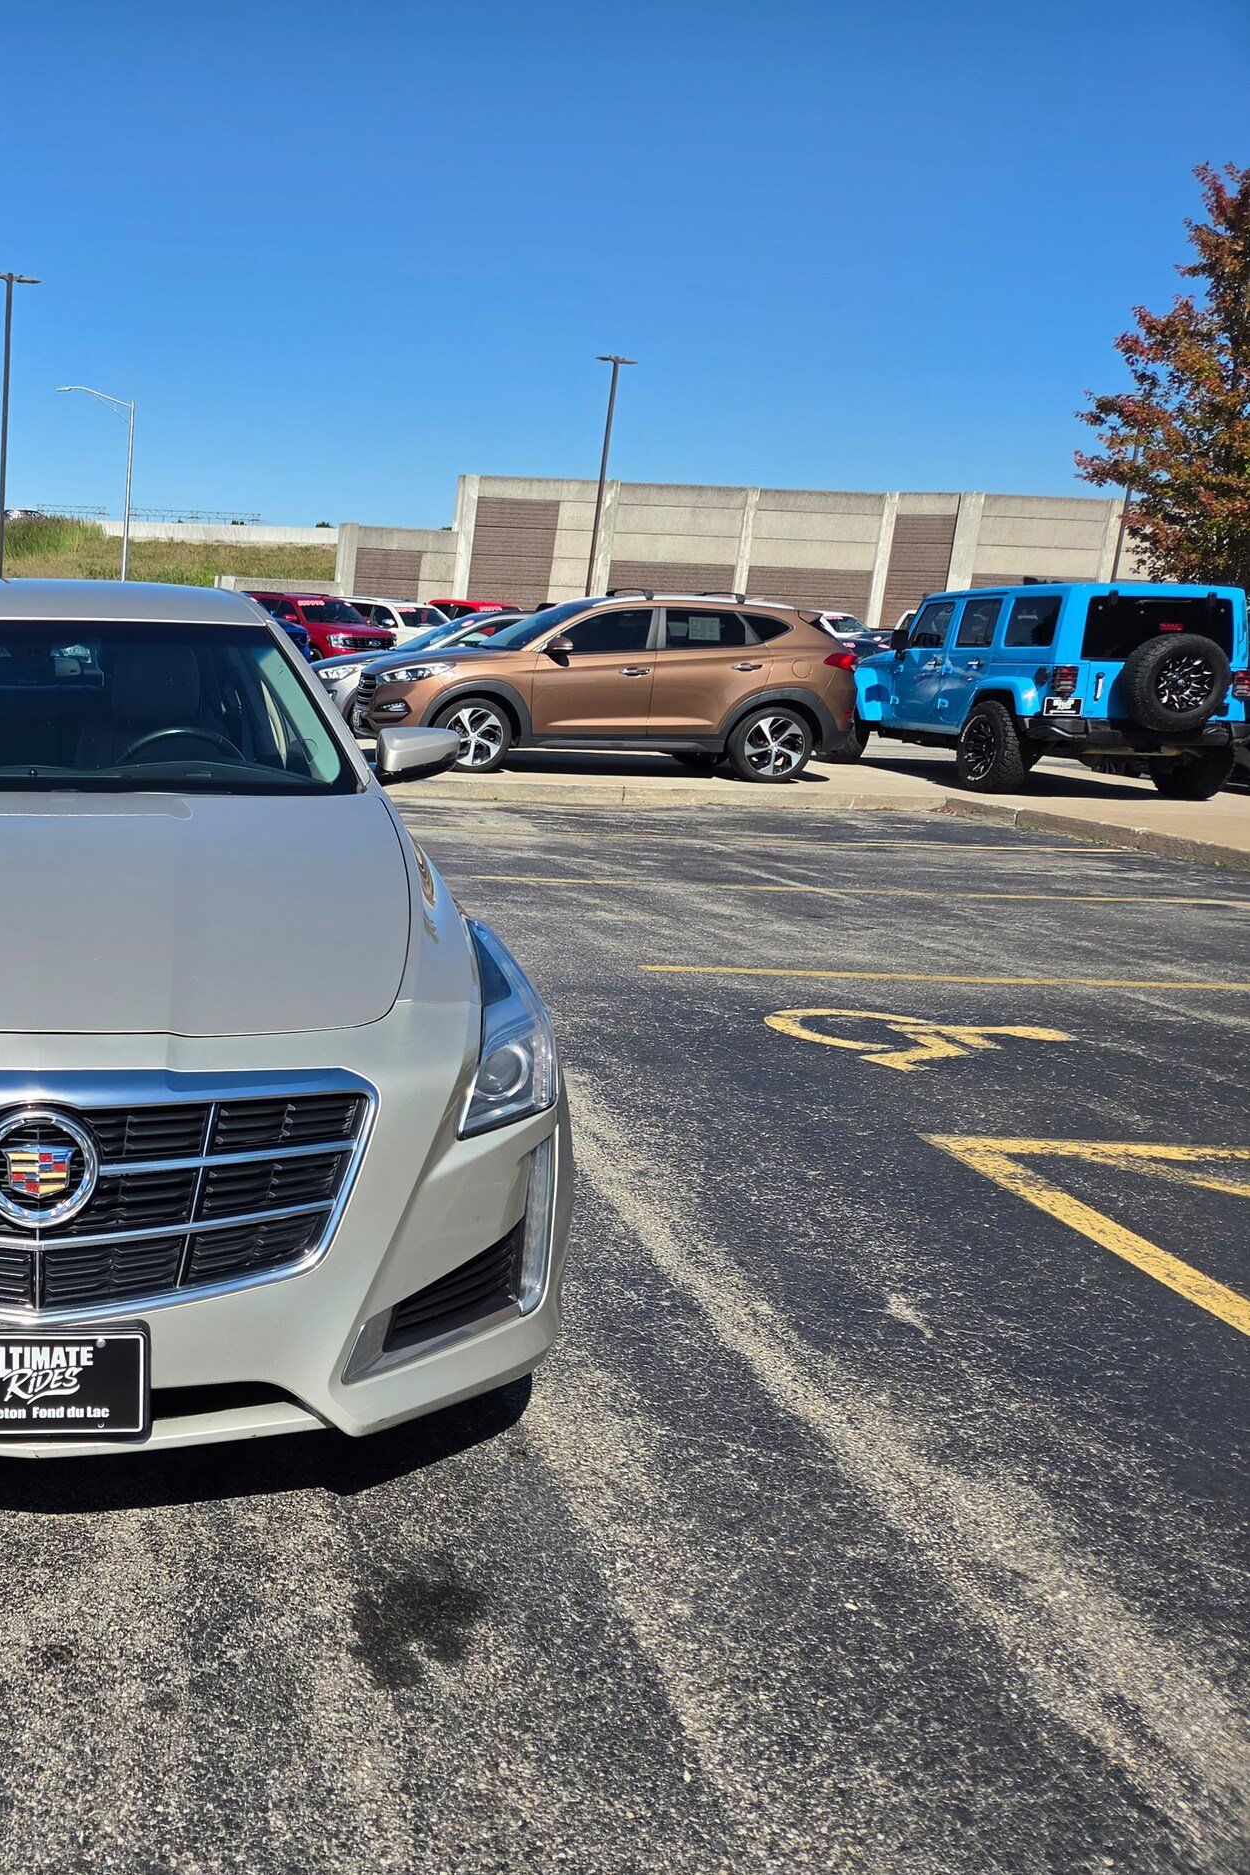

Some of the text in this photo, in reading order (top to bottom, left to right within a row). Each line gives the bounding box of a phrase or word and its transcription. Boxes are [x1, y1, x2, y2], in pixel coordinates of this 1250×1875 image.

[32, 1406, 65, 1419] Fond
[66, 1406, 85, 1418] du
[86, 1406, 110, 1418] Lac
